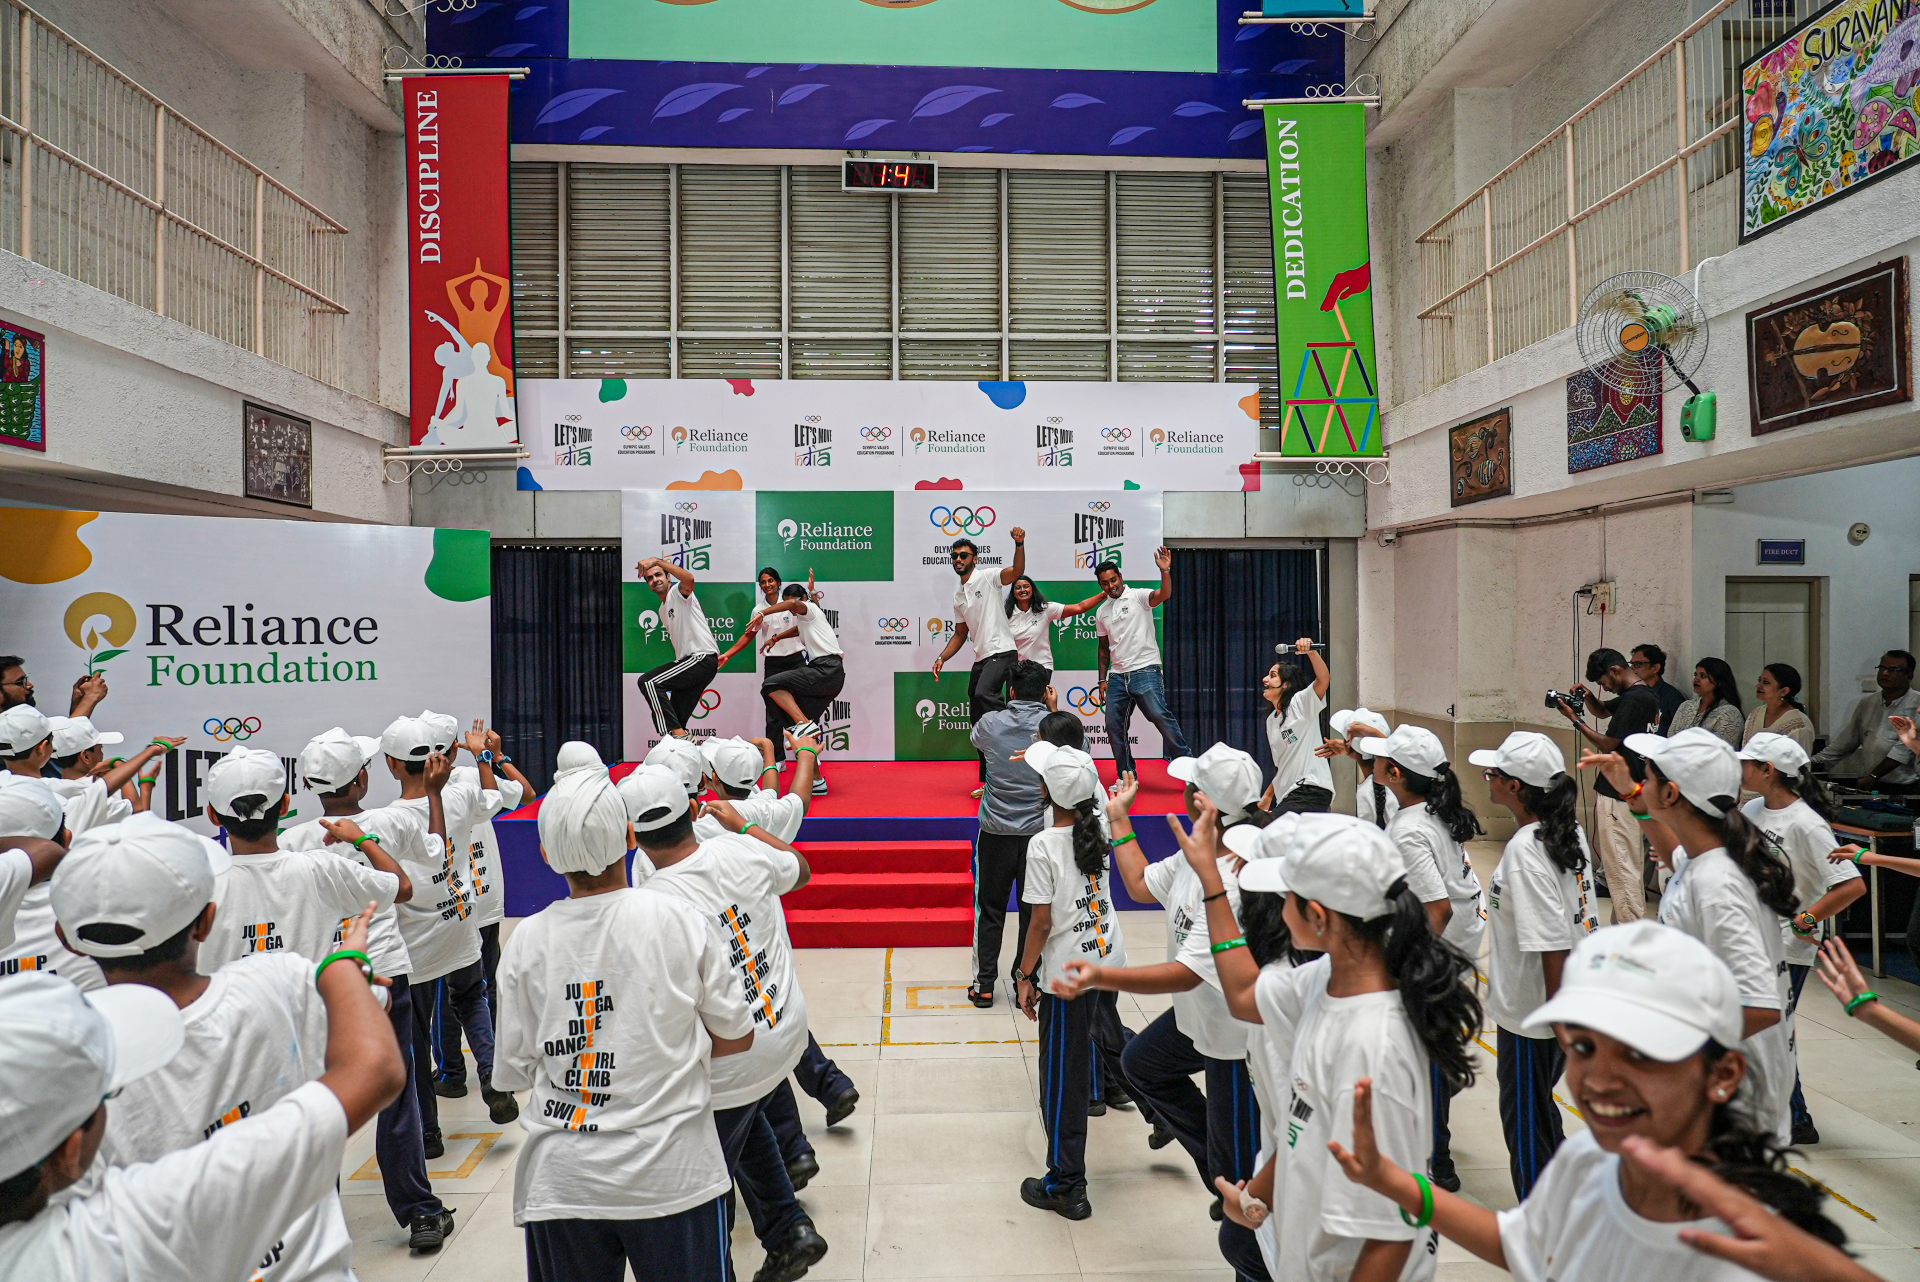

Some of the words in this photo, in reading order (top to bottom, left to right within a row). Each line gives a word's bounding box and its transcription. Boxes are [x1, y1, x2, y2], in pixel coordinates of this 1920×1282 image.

[417, 90, 441, 264] DISCIPLINE
[1277, 117, 1307, 300] DEDICATION
[555, 423, 577, 447] LET'S
[578, 427, 592, 443] MOVE
[689, 428, 748, 441] Reliance
[795, 424, 817, 447] LET'S
[928, 429, 986, 442] Reliance
[1036, 425, 1058, 448] LET'S
[1167, 430, 1224, 443] Reliance
[689, 443, 748, 452] Foundation
[928, 443, 986, 453] Foundation
[1167, 444, 1224, 453] Foundation
[661, 513, 692, 545] LET'S
[693, 518, 712, 540] MOVE
[799, 522, 873, 537] Reliance
[1074, 513, 1104, 544] LET'S
[1105, 517, 1124, 539] MOVE
[800, 538, 872, 550] Foundation
[934, 545, 953, 554] OLYM
[145, 603, 378, 646] Reliance
[146, 652, 378, 687] Foundation
[832, 700, 851, 721] MOVE
[691, 729, 717, 737] VALUES
[475, 885, 490, 896] LEAP
[1085, 881, 1101, 895] DIVE
[442, 903, 464, 920] SWIM
[458, 905, 472, 921] LEAP
[242, 922, 275, 939] JUMP
[729, 912, 751, 936] YOGA
[250, 935, 284, 953] YOGA
[730, 929, 750, 952] DIVE
[1081, 936, 1106, 953] SWIM
[741, 948, 767, 976] TWIRL
[1098, 944, 1113, 959] LEAP
[0, 954, 48, 976] JUMP
[744, 961, 770, 990] CLIMB
[565, 980, 604, 1001] JUMP
[575, 995, 614, 1017] YOGA
[568, 1015, 602, 1037] DIVE
[544, 1033, 595, 1057] DANCE
[565, 1070, 611, 1089] CLIMB
[543, 1099, 588, 1126] SWIM
